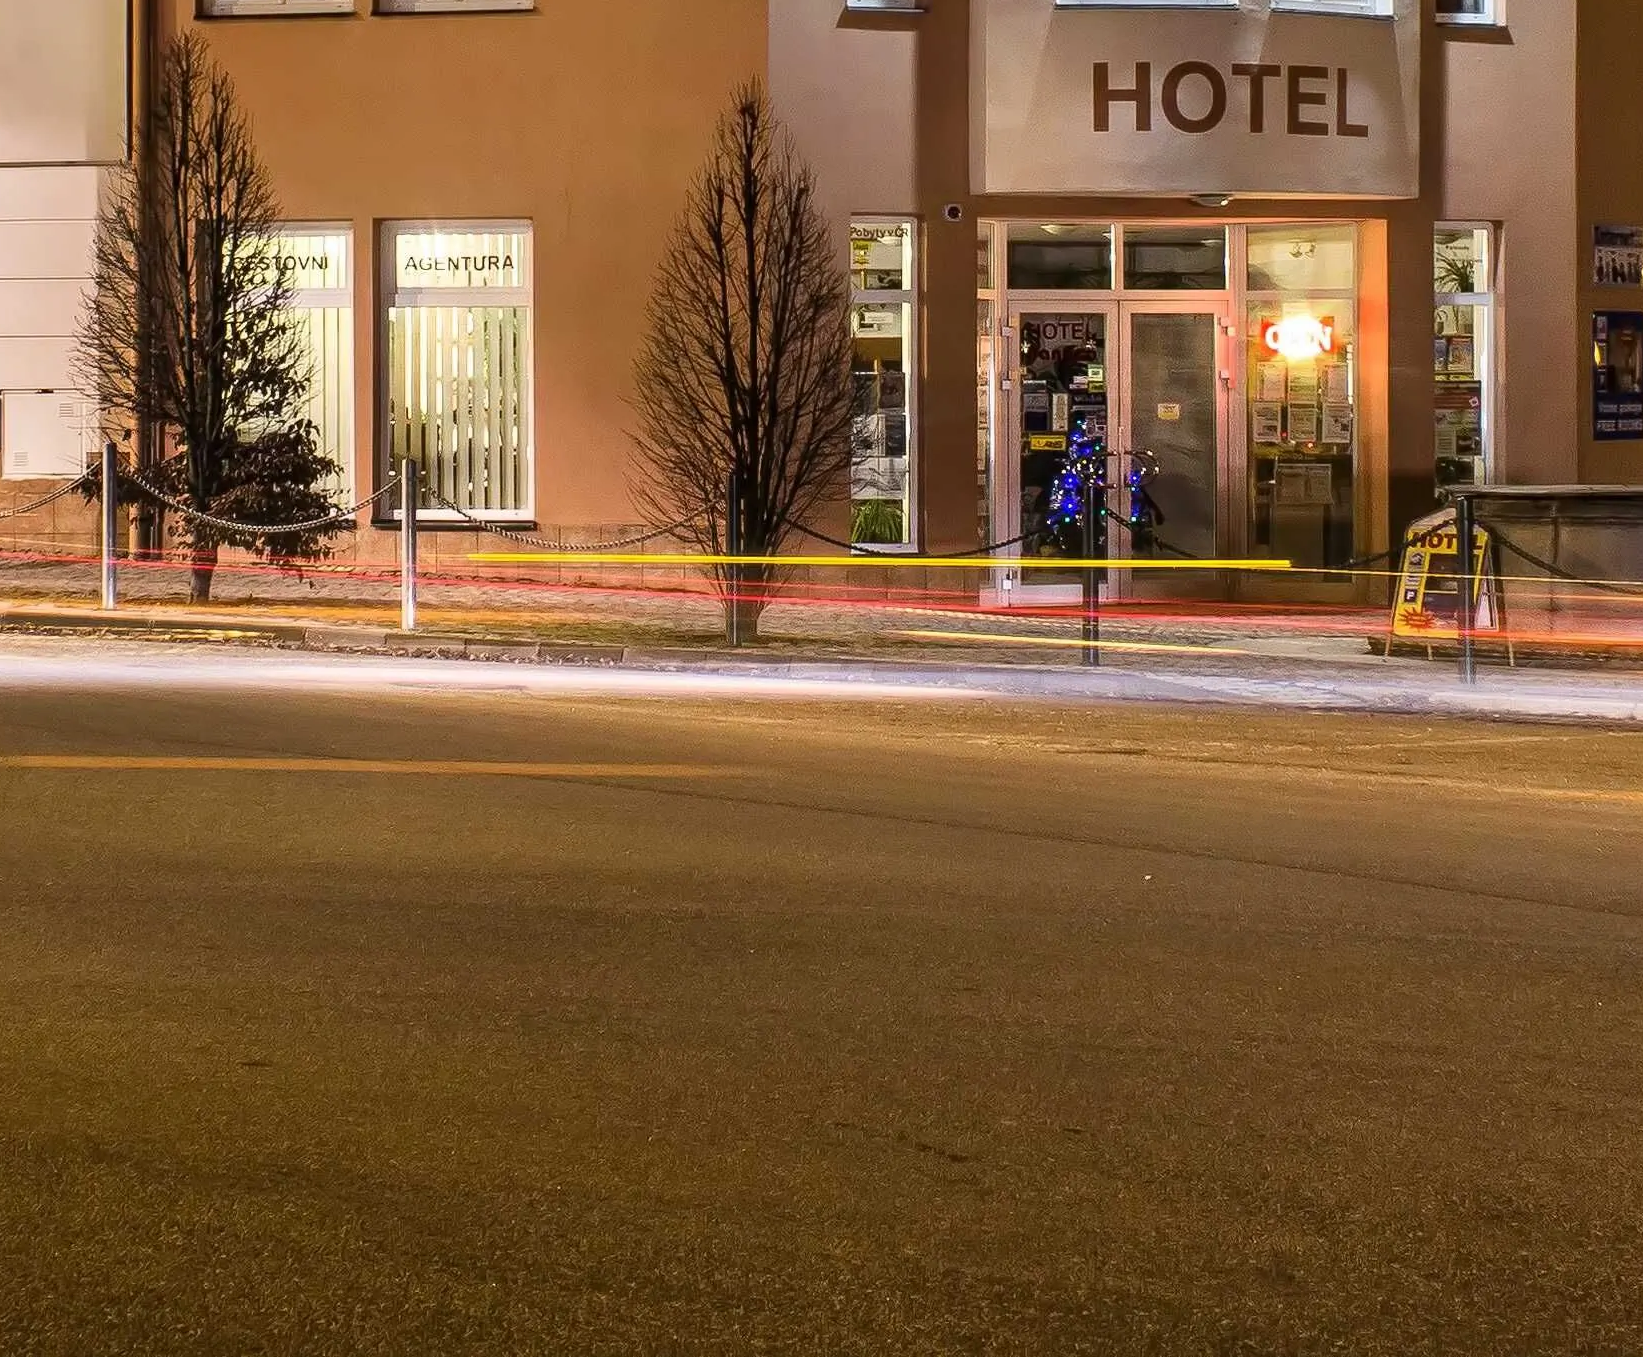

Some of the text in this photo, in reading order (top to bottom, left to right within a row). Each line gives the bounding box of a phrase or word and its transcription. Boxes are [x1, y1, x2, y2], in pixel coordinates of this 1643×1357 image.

[1092, 61, 1368, 138] HOTEL
[405, 255, 514, 271] AGENTURA
[1265, 324, 1333, 352] ON
[1412, 532, 1483, 550] HOTL
